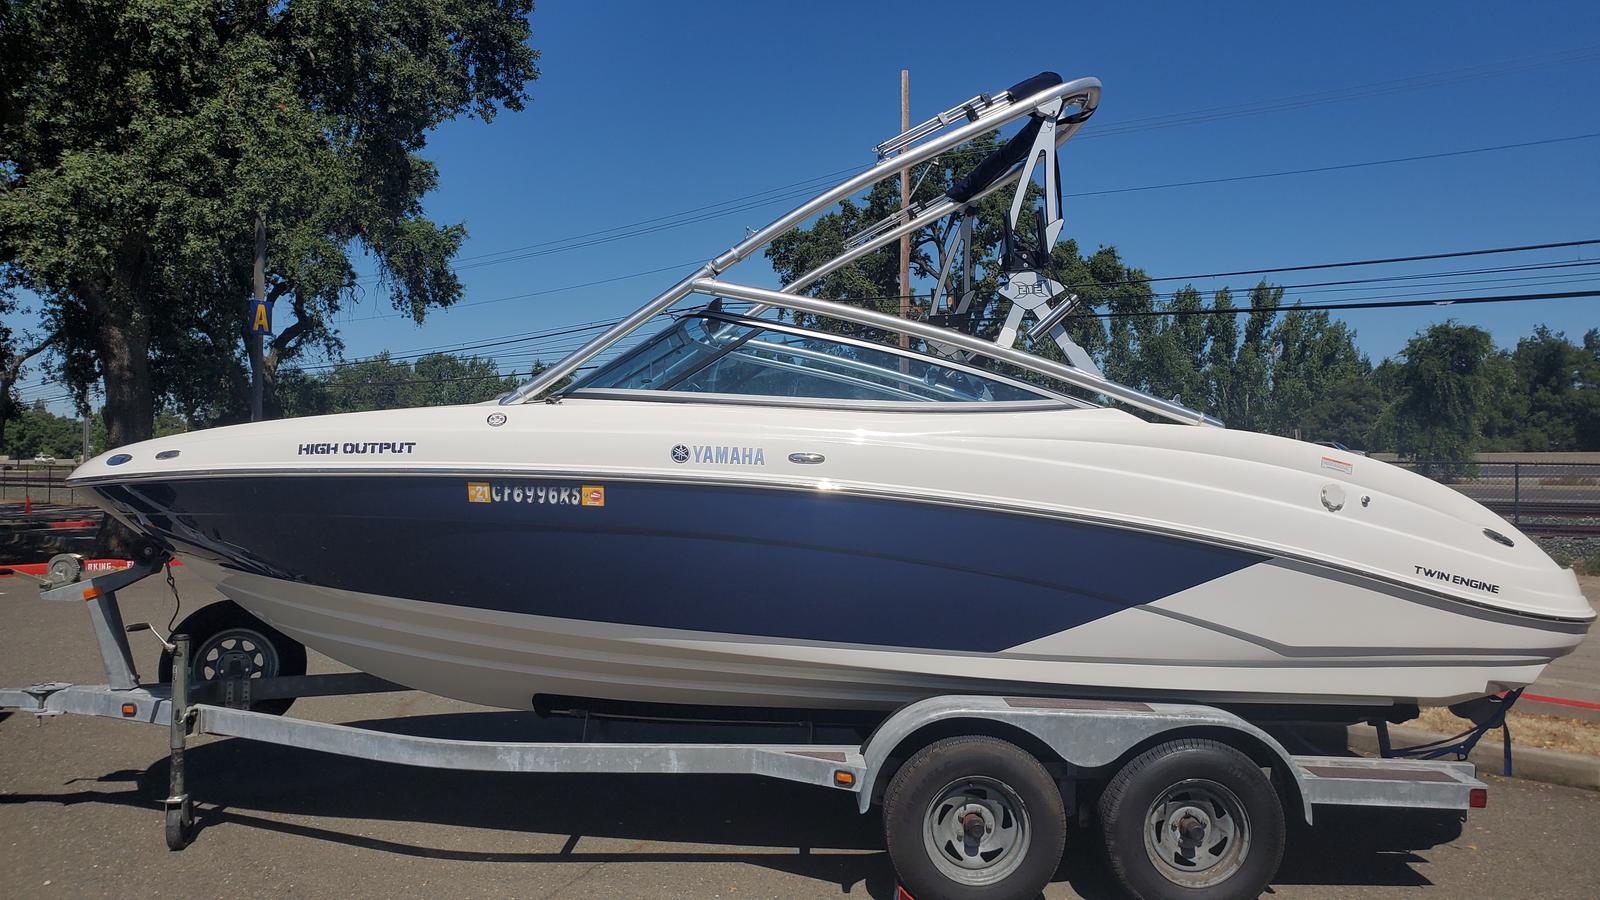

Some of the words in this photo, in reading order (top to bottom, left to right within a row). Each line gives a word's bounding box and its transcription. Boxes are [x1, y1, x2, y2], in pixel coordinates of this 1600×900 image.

[253, 303, 269, 332] A
[298, 443, 338, 455] HIGH
[342, 442, 416, 454] OUTPUT
[693, 445, 765, 465] YAMAHA
[87, 562, 112, 571] RKING
[1414, 565, 1451, 582] TWIN
[1451, 575, 1500, 594] ENGINE
